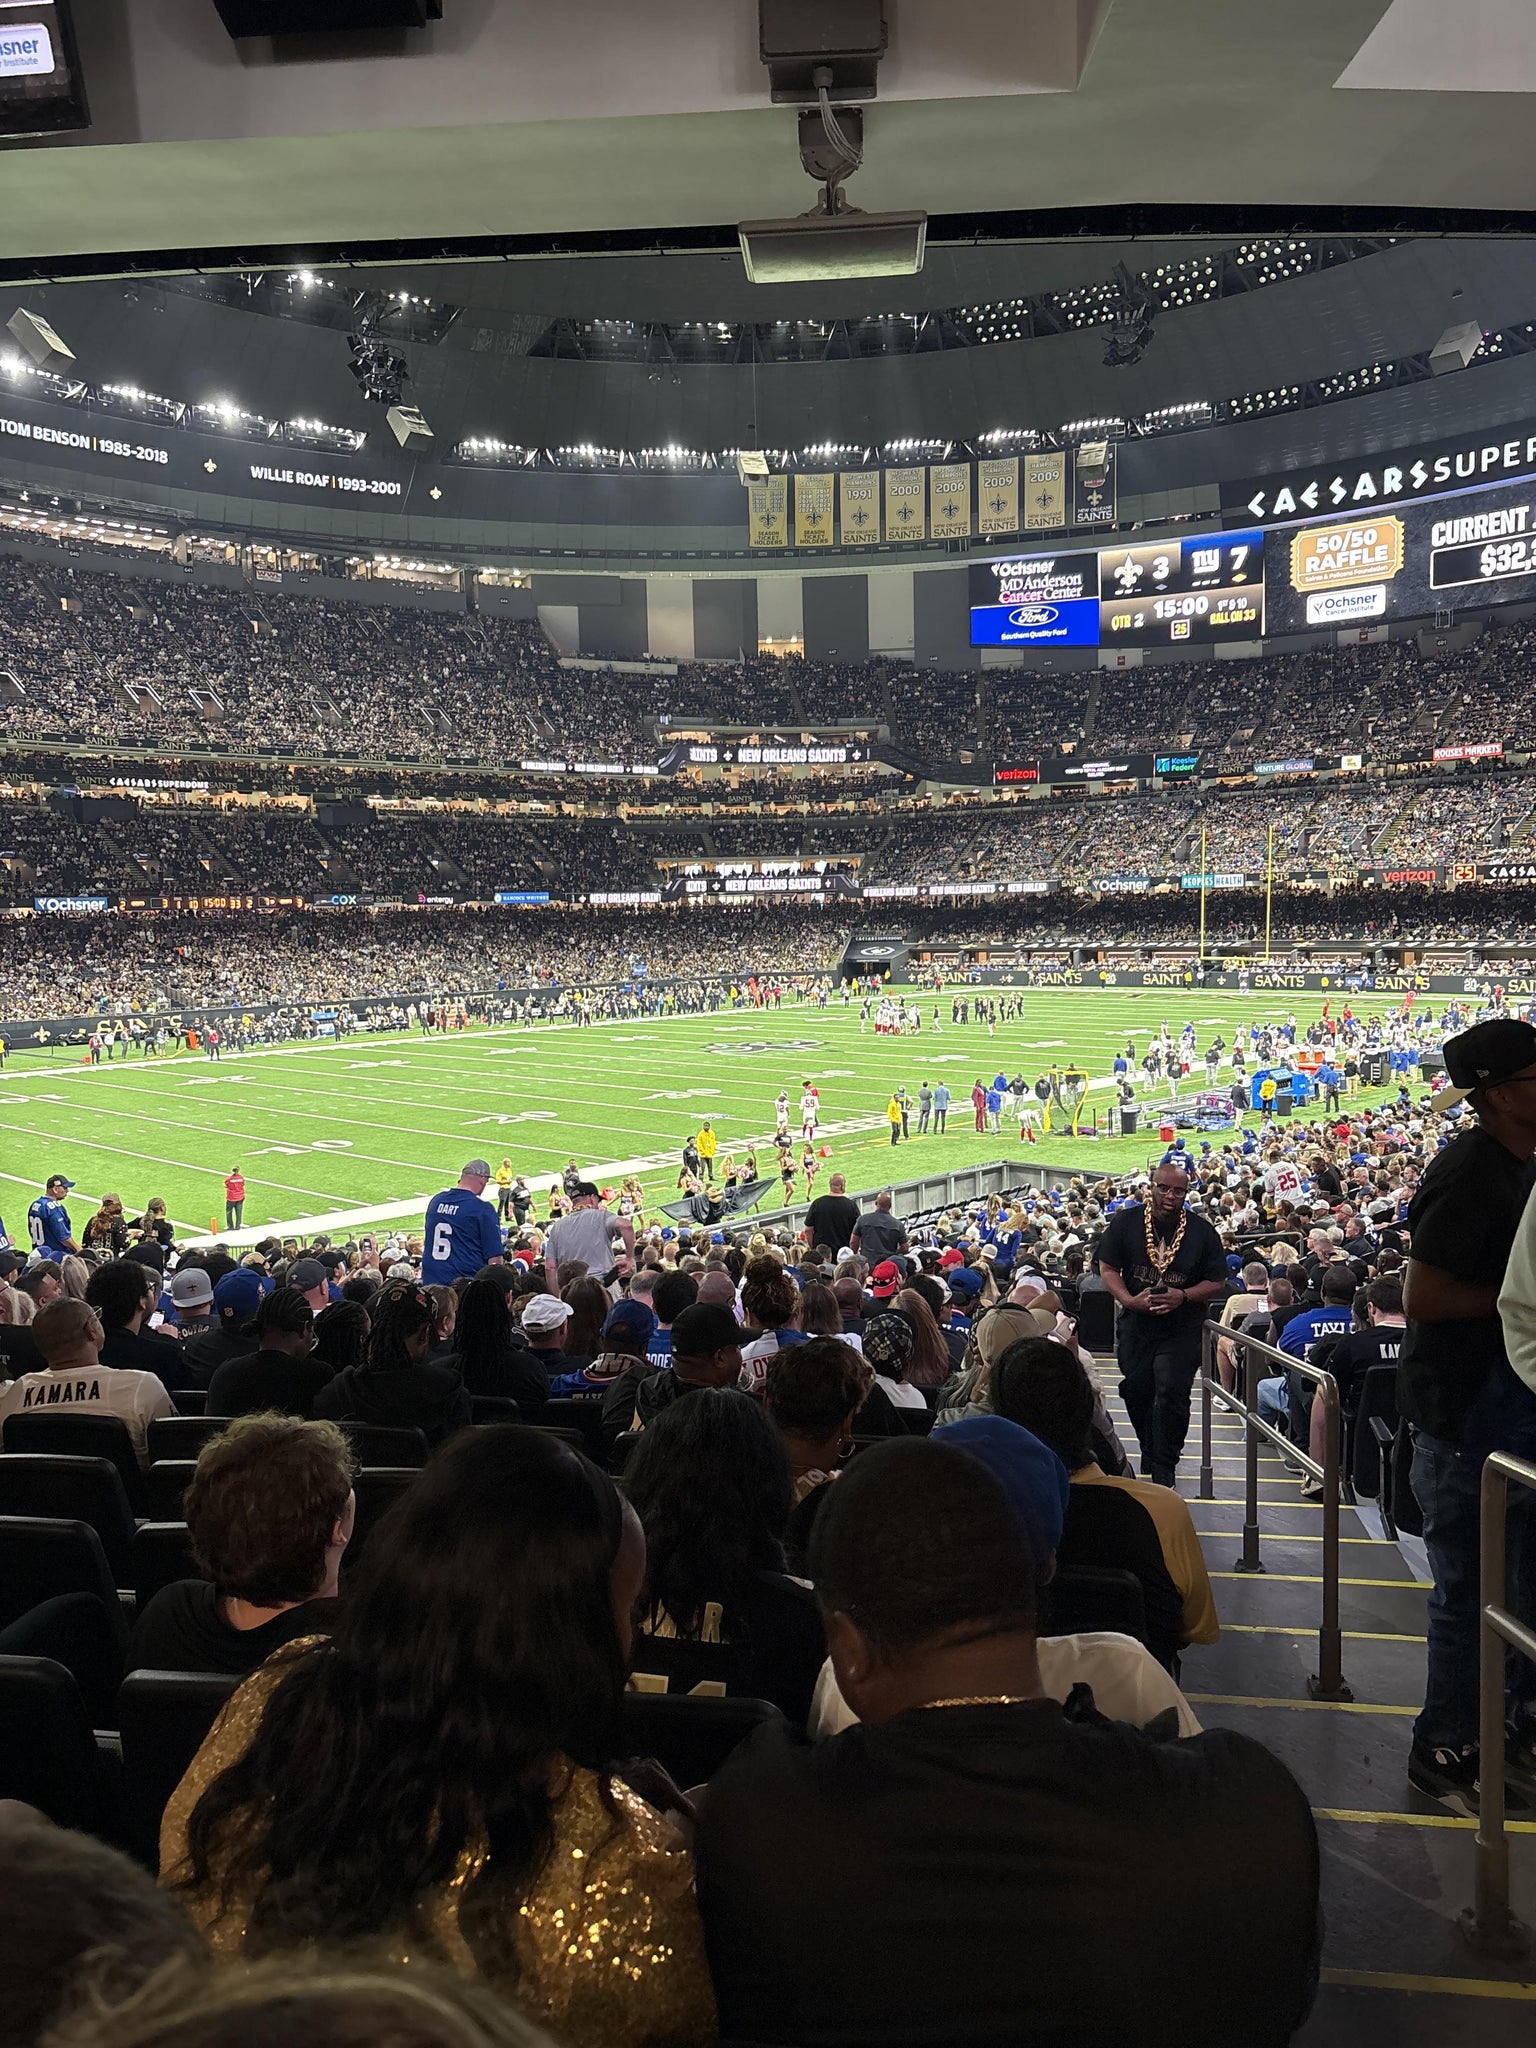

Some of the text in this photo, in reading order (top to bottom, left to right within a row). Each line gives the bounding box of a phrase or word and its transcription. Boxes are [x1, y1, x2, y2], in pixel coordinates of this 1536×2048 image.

[0, 419, 168, 464] TOM BENSON 1985-2018
[251, 466, 400, 495] WILLIE ROAF 1993-2001
[984, 476, 1013, 488] 2009
[1029, 470, 1061, 483] 2009
[891, 485, 920, 496] 2000
[935, 482, 965, 493] 2006
[847, 489, 872, 500] 1991
[1027, 516, 1062, 528] SAINTS
[1077, 510, 1113, 522] SAINTS
[934, 527, 968, 537] SAINTS
[982, 520, 1016, 532] SAINTS
[1431, 505, 1530, 547] CURRENT
[843, 534, 878, 543] SAINTS
[888, 530, 922, 540] SAINTS
[1315, 528, 1378, 554] 50/50
[1152, 556, 1170, 580] 3
[1230, 546, 1249, 570] 7
[1305, 544, 1389, 573] RAFFLE
[1000, 560, 1055, 577] Ochsner
[1354, 565, 1389, 576] Foundation
[1000, 574, 1082, 592] MD Anderson
[999, 586, 1083, 603] Cancer Center
[1153, 596, 1210, 619] 15:00
[1237, 597, 1248, 609] 10
[1325, 594, 1377, 609] Ochsner
[1018, 608, 1049, 623] Ford
[1326, 604, 1374, 616] Cancer Institute
[1111, 613, 1145, 631] QTR 2
[1210, 608, 1256, 625] BALL ON 33
[1001, 628, 1068, 641] Southern Quality Ford
[1174, 623, 1187, 635] 25
[6, 729, 43, 741] SAINTS
[85, 737, 120, 747] SAINTS
[158, 741, 190, 751] SAINTS
[228, 745, 259, 754] SAINTS
[294, 749, 323, 758] SAINTS
[738, 748, 847, 763] NEW ORLEANS SAINTS
[1434, 744, 1501, 759] ROUSES MARKETS
[358, 753, 386, 761] SAINTS
[418, 756, 446, 765] SAINTS
[478, 759, 505, 767] SAINTS
[1371, 753, 1401, 762] SAINTS
[1218, 765, 1245, 774] SAINTS
[1254, 761, 1313, 773] VENTURE GLOBAL
[75, 776, 107, 785] SAINTS
[996, 769, 1036, 781] verizon
[157, 779, 209, 790] SUPERDOME
[209, 781, 238, 790] SAINTS
[272, 784, 300, 792] SAINTS
[335, 787, 362, 795] SAINTS
[394, 789, 420, 797] SAINTS
[1327, 870, 1359, 879] SAINTS
[1382, 869, 1437, 882] verizon
[1455, 866, 1473, 879] 25
[725, 878, 822, 892] NEW ORLEANS SAINTS
[1061, 878, 1089, 888] SAINTS
[1099, 878, 1149, 891] Ochsner
[1215, 874, 1243, 886] HEALTH
[331, 895, 357, 905] COX
[376, 895, 403, 903] SAINTS
[427, 896, 454, 904] entergy
[590, 893, 640, 903] NEW ORLEANS
[47, 898, 105, 911] Ochsner
[119, 901, 126, 910] 2
[162, 899, 169, 908] 3
[189, 901, 199, 910] 10
[230, 899, 241, 909] 33
[777, 1104, 785, 1113] 12
[805, 1099, 815, 1108] 59
[1277, 1171, 1298, 1191] 25
[437, 1203, 459, 1215] DART
[432, 1222, 452, 1261] 6
[23, 1380, 101, 1408] KAMARA
